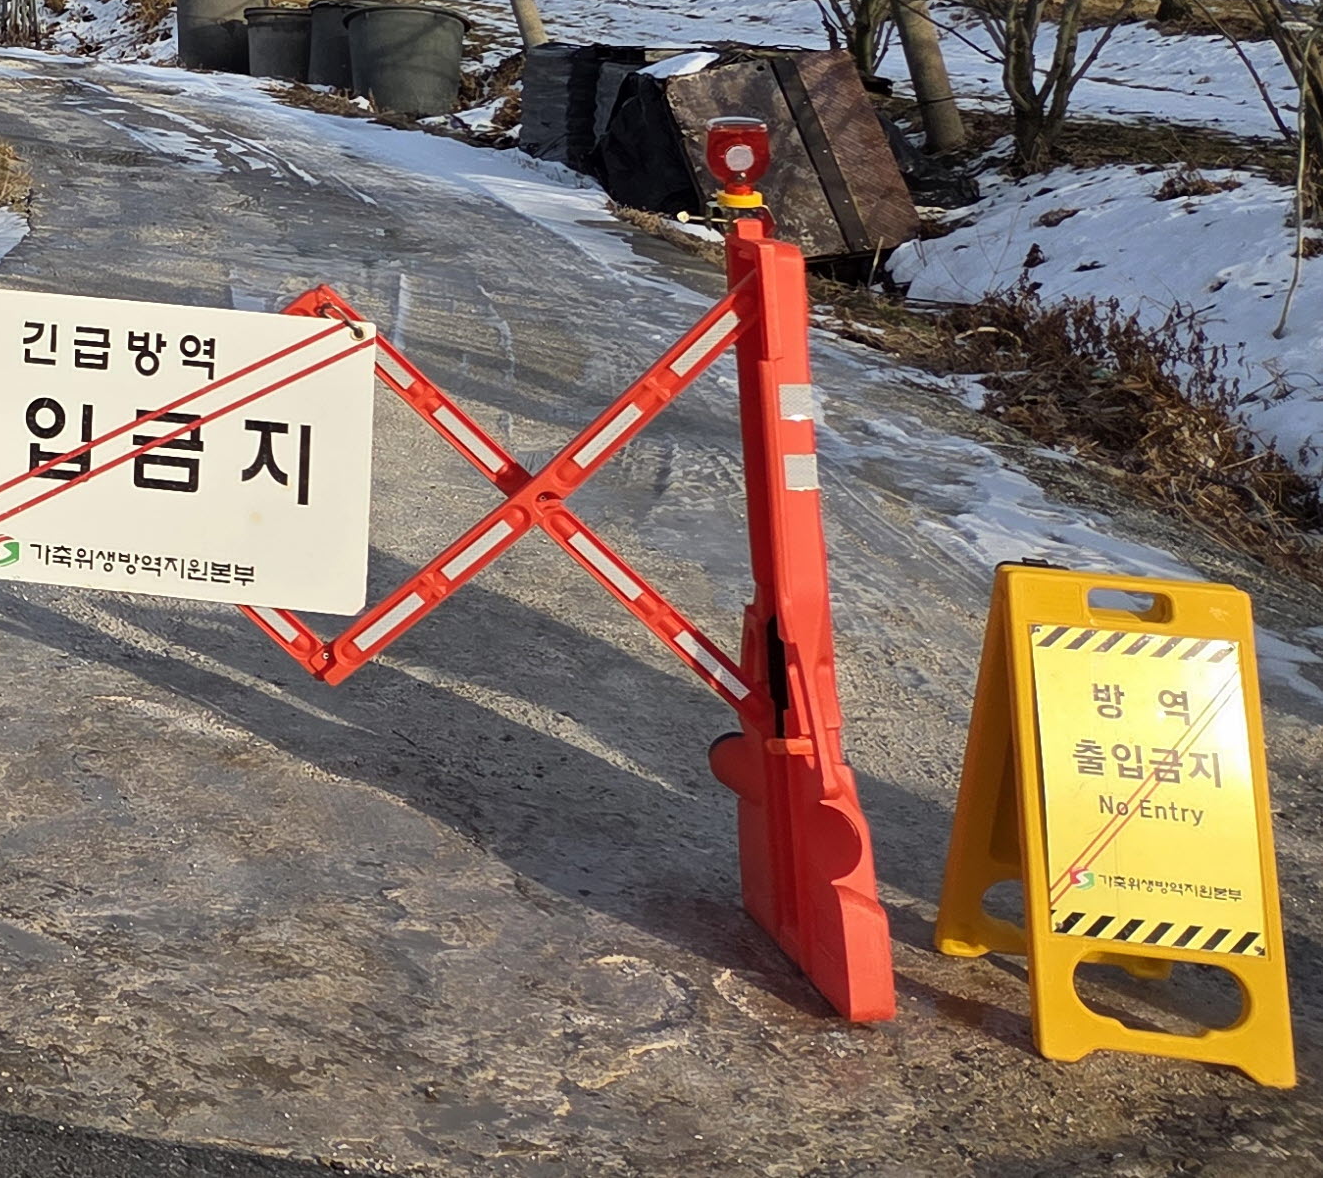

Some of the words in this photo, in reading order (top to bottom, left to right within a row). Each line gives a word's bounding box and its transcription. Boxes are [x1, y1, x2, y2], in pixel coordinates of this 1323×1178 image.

[22, 319, 218, 380] 긴급방역
[29, 542, 256, 587] 가축위생방역지원본부
[1072, 738, 1224, 789] 출입금지
[1099, 794, 1129, 818] No
[1139, 798, 1205, 828] Entry
[1098, 874, 1243, 902] 가축위생방역지원본부
